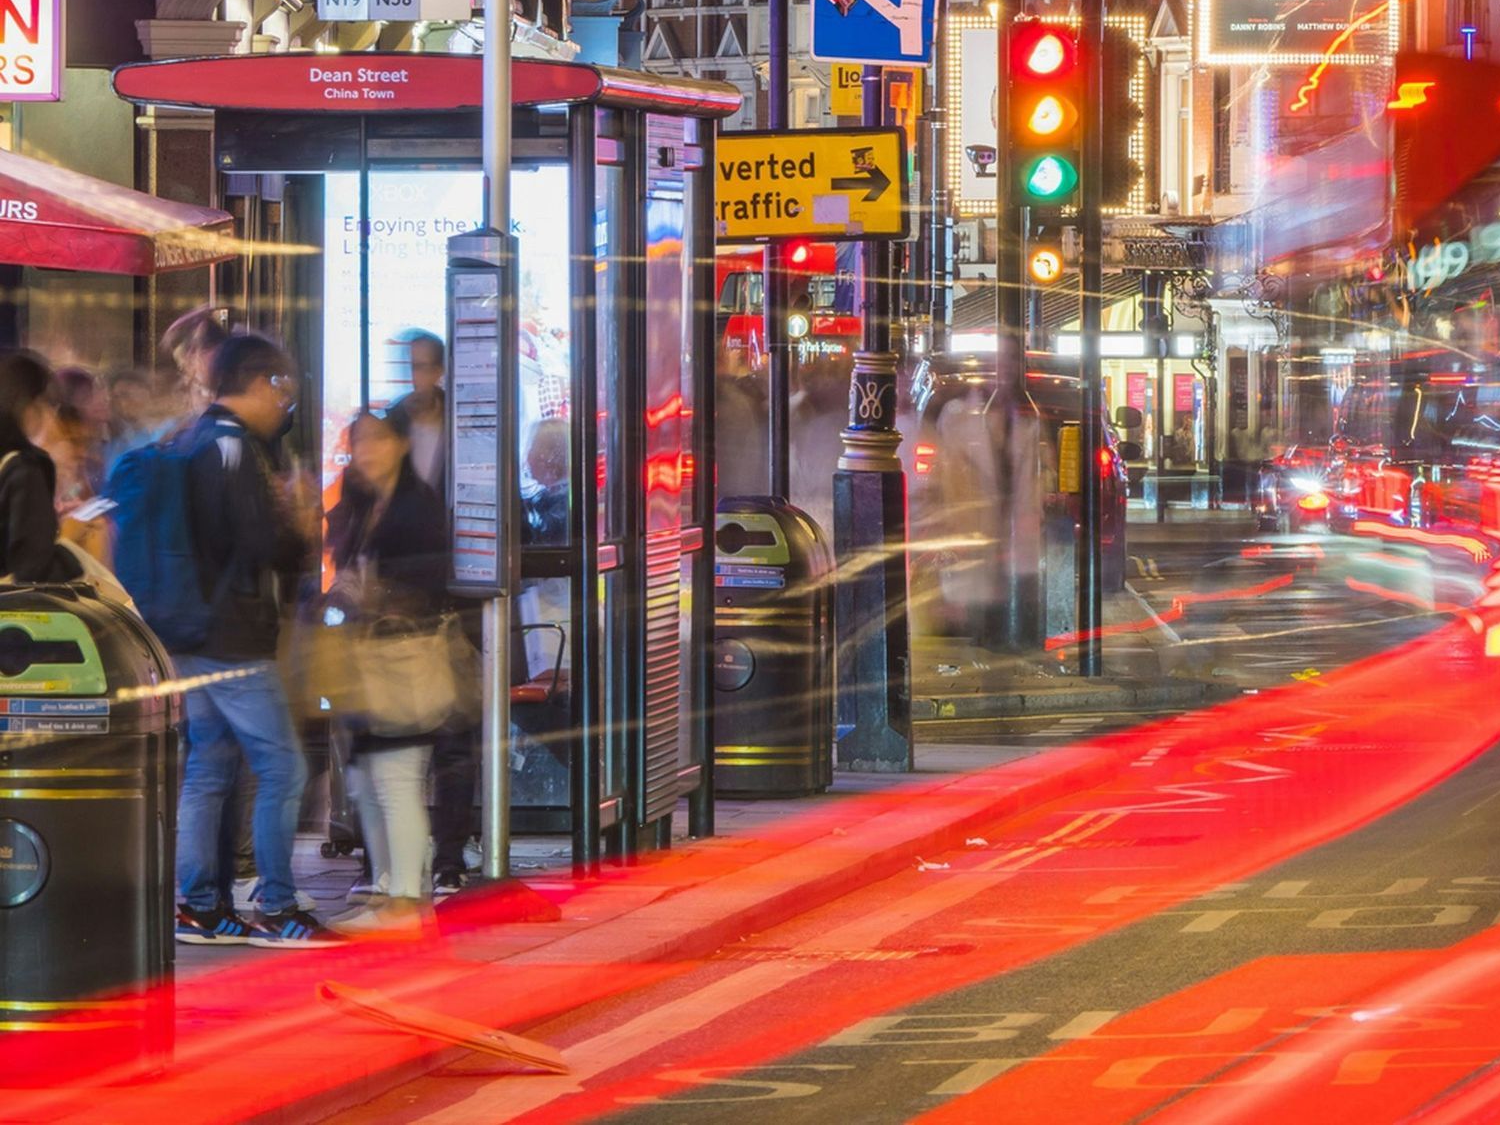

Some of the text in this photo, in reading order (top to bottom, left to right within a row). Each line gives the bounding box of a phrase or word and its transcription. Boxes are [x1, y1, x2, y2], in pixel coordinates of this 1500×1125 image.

[1230, 23, 1286, 31] DANNY ROBINS
[1296, 23, 1334, 31] MATTHEW
[309, 68, 409, 82] Dean Street
[838, 67, 862, 89] LIO
[324, 87, 395, 99] China Town
[433, 216, 467, 233] the
